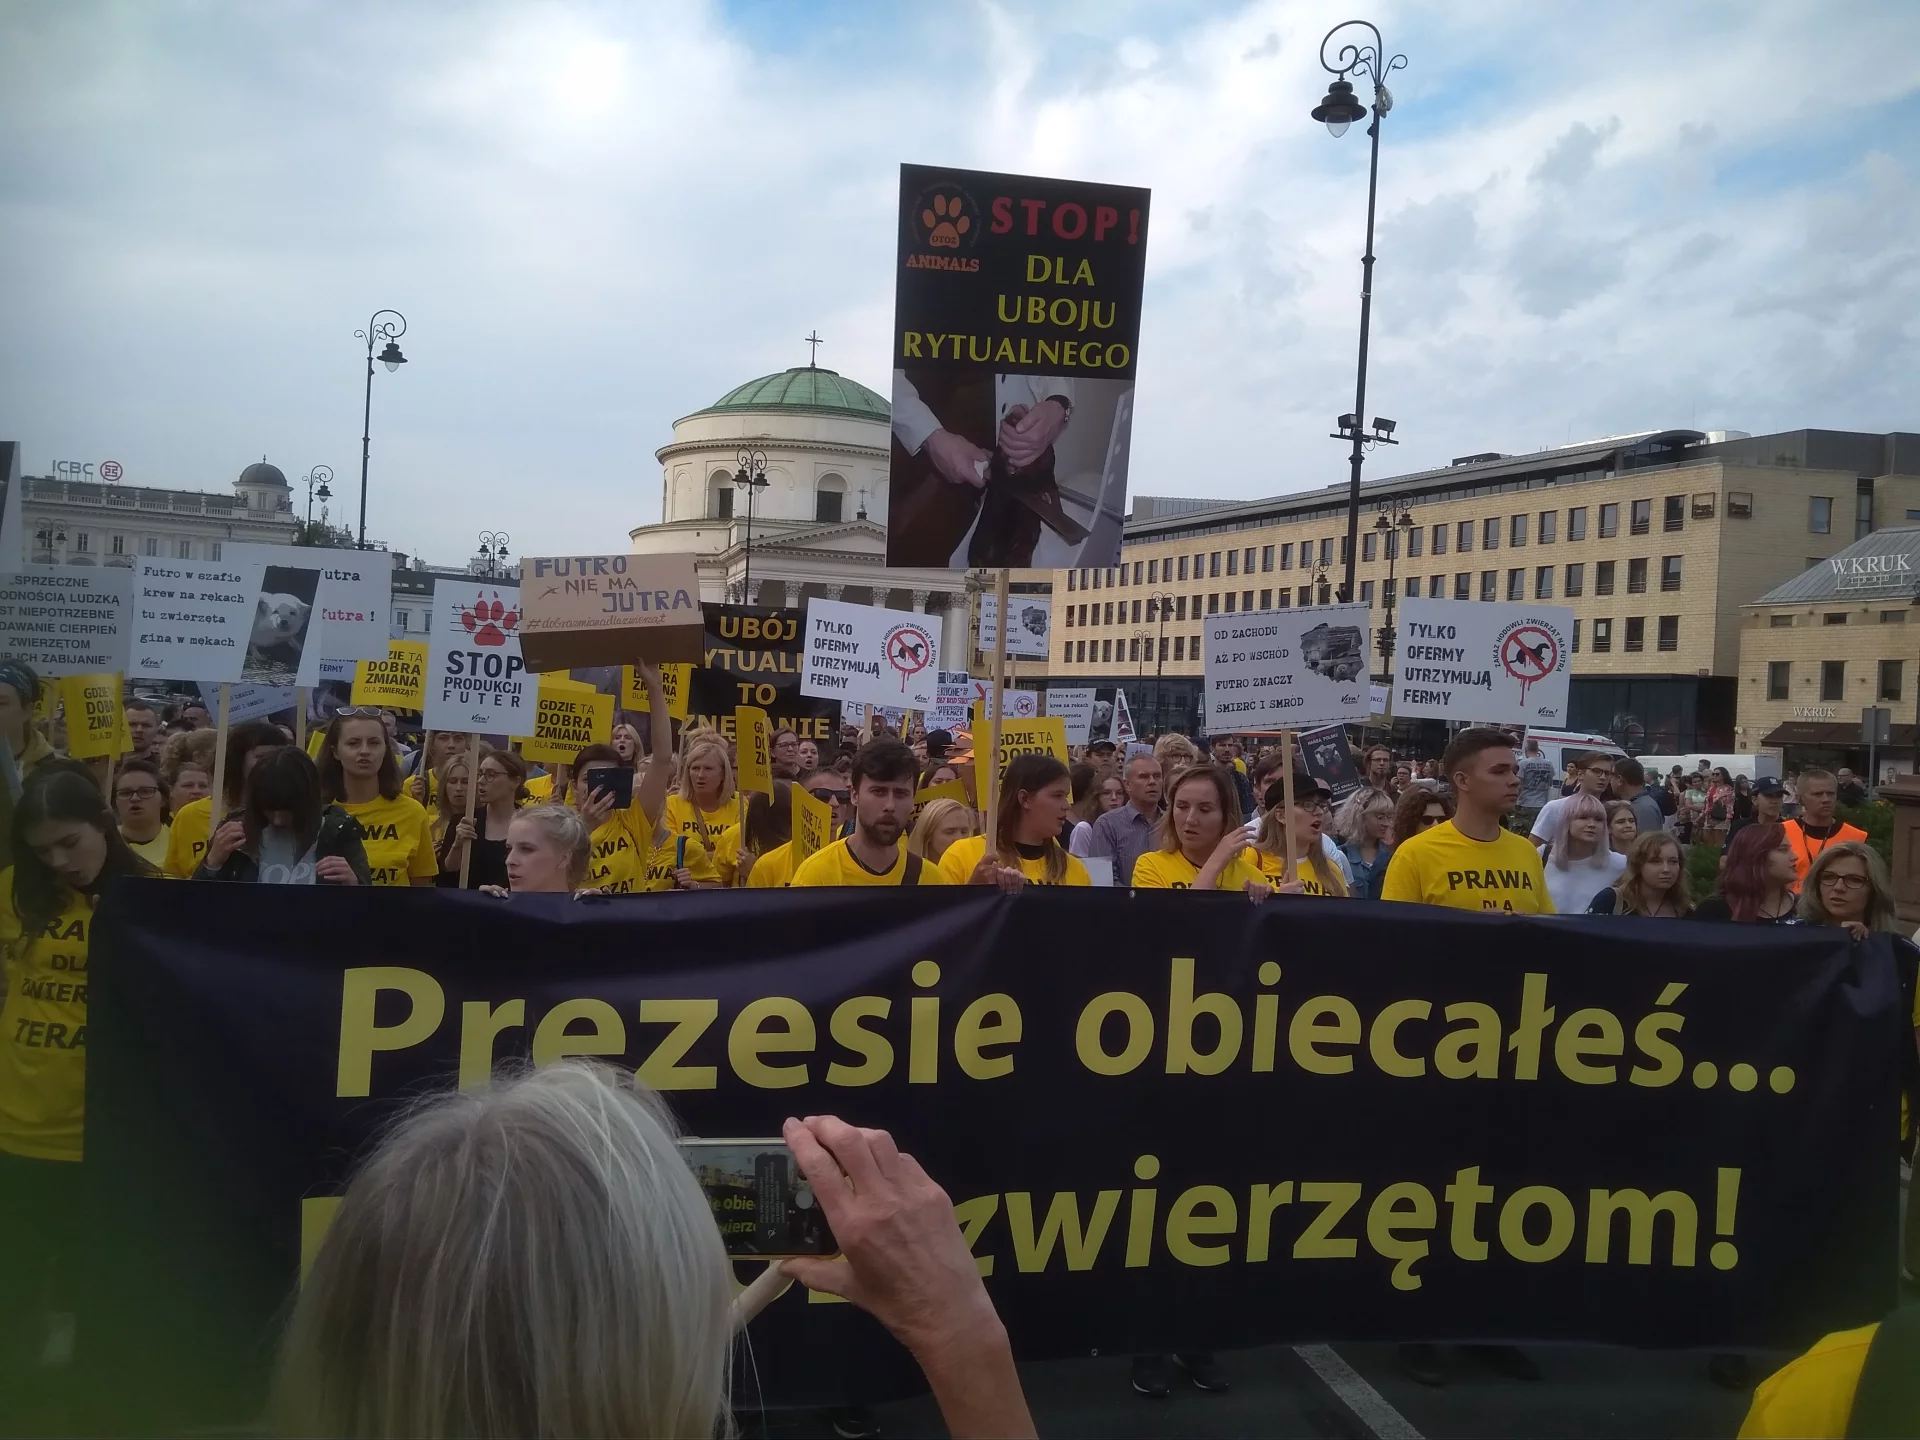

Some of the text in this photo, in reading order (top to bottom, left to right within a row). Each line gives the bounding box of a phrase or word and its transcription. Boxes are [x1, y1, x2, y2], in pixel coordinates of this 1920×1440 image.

[990, 196, 1140, 245] STOP!
[931, 235, 957, 245] OTOZ
[905, 253, 980, 273] ANIMALS
[1026, 254, 1096, 287] DLA
[997, 294, 1116, 332] UBOJU
[903, 331, 1130, 369] RYTUALNEGO
[52, 459, 94, 475] ICBC
[143, 566, 242, 583] Futro w szafie
[321, 568, 361, 582] utra
[534, 556, 627, 578] FUTRO
[142, 587, 245, 604] krew na rękach
[565, 577, 638, 597] NIE MA
[0, 590, 120, 606] ODNOŚCIĄ LUDZKĄ
[601, 589, 693, 613] JUTRA
[0, 606, 115, 620] ST NIEPOTRZEBNE
[141, 609, 226, 624] tu zwierzęta
[0, 621, 117, 635] DAWANIE CIERPIEŃ
[720, 611, 798, 641] UBÓJ
[815, 618, 853, 636] TYLKO
[1213, 625, 1278, 641] OD ZACHODU
[1408, 622, 1456, 640] TYLKO
[8, 636, 91, 650] ZWIERZĘTOM
[139, 632, 235, 648] giną w mękach
[813, 637, 860, 654] OFERMY
[1492, 618, 1567, 673] ZAKAZ HODOWLI ZWIERZĄT NA FUTRA
[388, 650, 424, 663] ZIE TA
[704, 648, 804, 674] YTUAL
[1214, 646, 1290, 664] AŻ PO WSCHÓD
[1407, 645, 1465, 663] OFERMY
[367, 661, 421, 676] DOBRA
[445, 650, 524, 680] STOP
[811, 655, 880, 679] UTRZYMUJĄ
[365, 673, 419, 688] ZMIANA
[443, 676, 522, 695] PRODUKCJI
[810, 673, 849, 689] FERMY
[1215, 674, 1293, 690] FUTRO ZNACZY
[1404, 667, 1492, 691] UTRZYMUJĄ
[442, 689, 520, 708] FUTER
[736, 682, 777, 705] TO
[1403, 688, 1452, 706] FERMY
[85, 700, 114, 715] DOBR
[539, 699, 595, 716] GDZIE TA
[1215, 694, 1304, 714] ŚMIERĆ I SMRÓD
[537, 711, 593, 730] DOBRA
[535, 725, 591, 743] ZMIANA
[1037, 731, 1054, 744] TA
[534, 740, 549, 749] DLA
[1447, 869, 1534, 891] PRAWA
[14, 1017, 86, 1050] TERA
[335, 956, 1797, 1098] Prezesie obiecałeś...
[952, 1153, 1743, 1292] zwierzętom!
